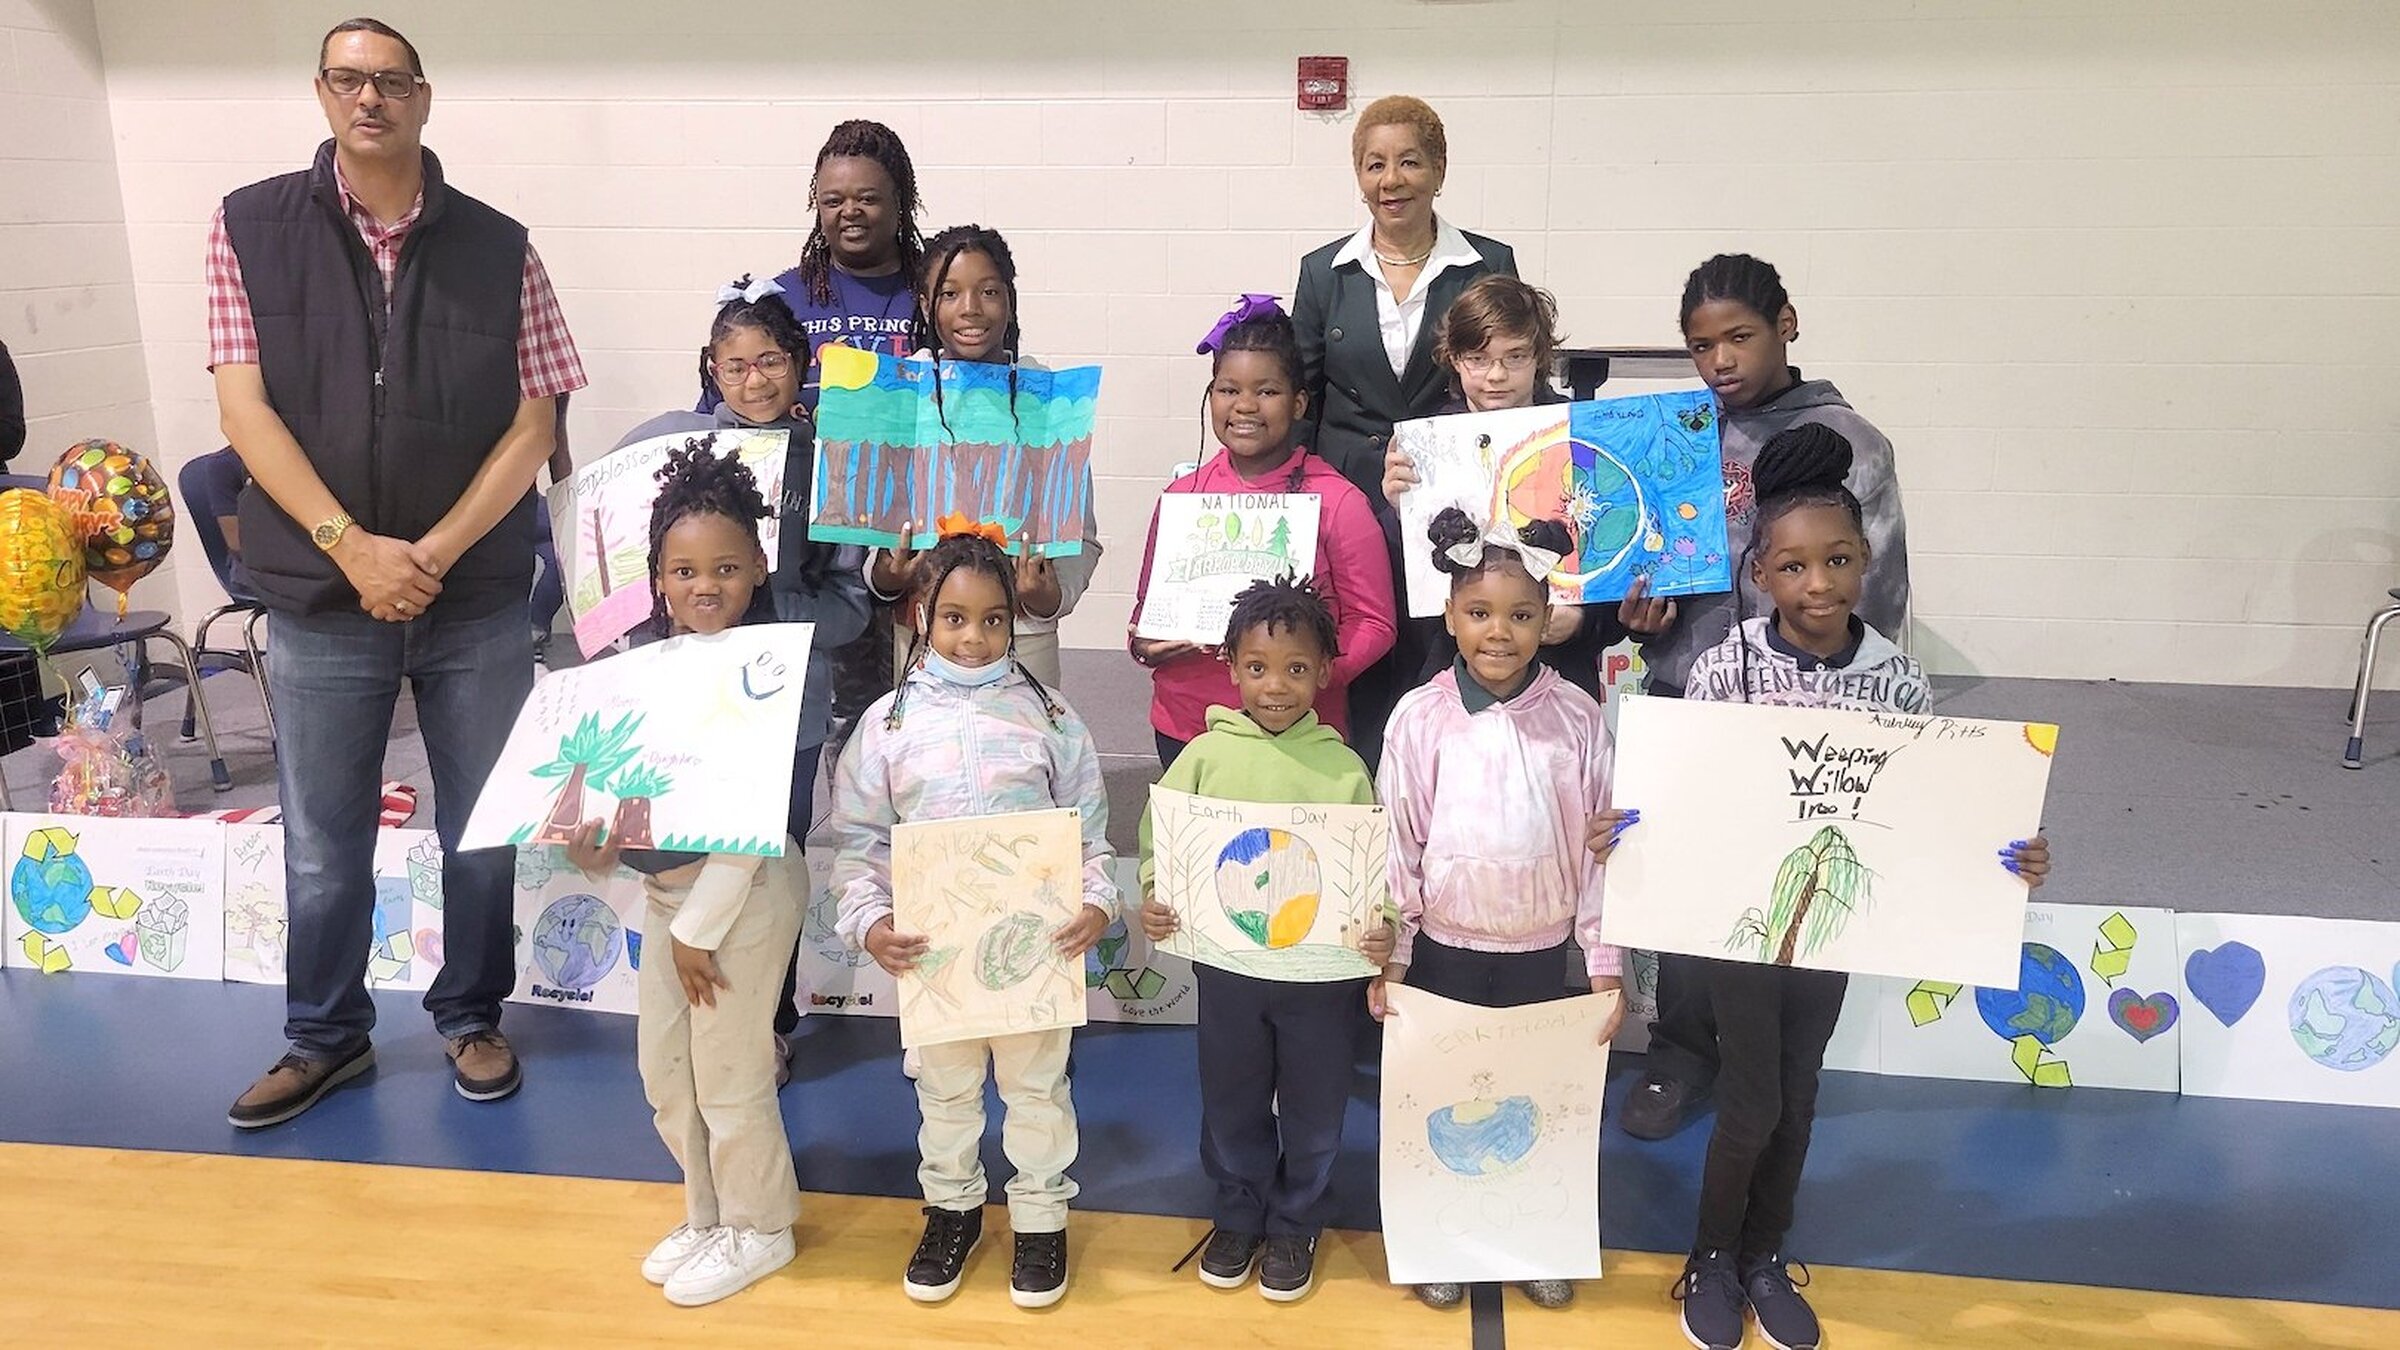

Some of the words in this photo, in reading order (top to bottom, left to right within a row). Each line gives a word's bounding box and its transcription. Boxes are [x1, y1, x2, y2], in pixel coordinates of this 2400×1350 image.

[1201, 494, 1290, 510] NATIONAL
[1709, 666, 1793, 701] QUEEN
[1798, 671, 1890, 703] QUEEN
[1780, 732, 1902, 774] Weeping
[1788, 763, 1874, 795] Willow
[1188, 797, 1243, 824] Earth
[1291, 806, 1328, 830] Day
[531, 983, 596, 1002] Recycle!
[1122, 1002, 1145, 1017] Love
